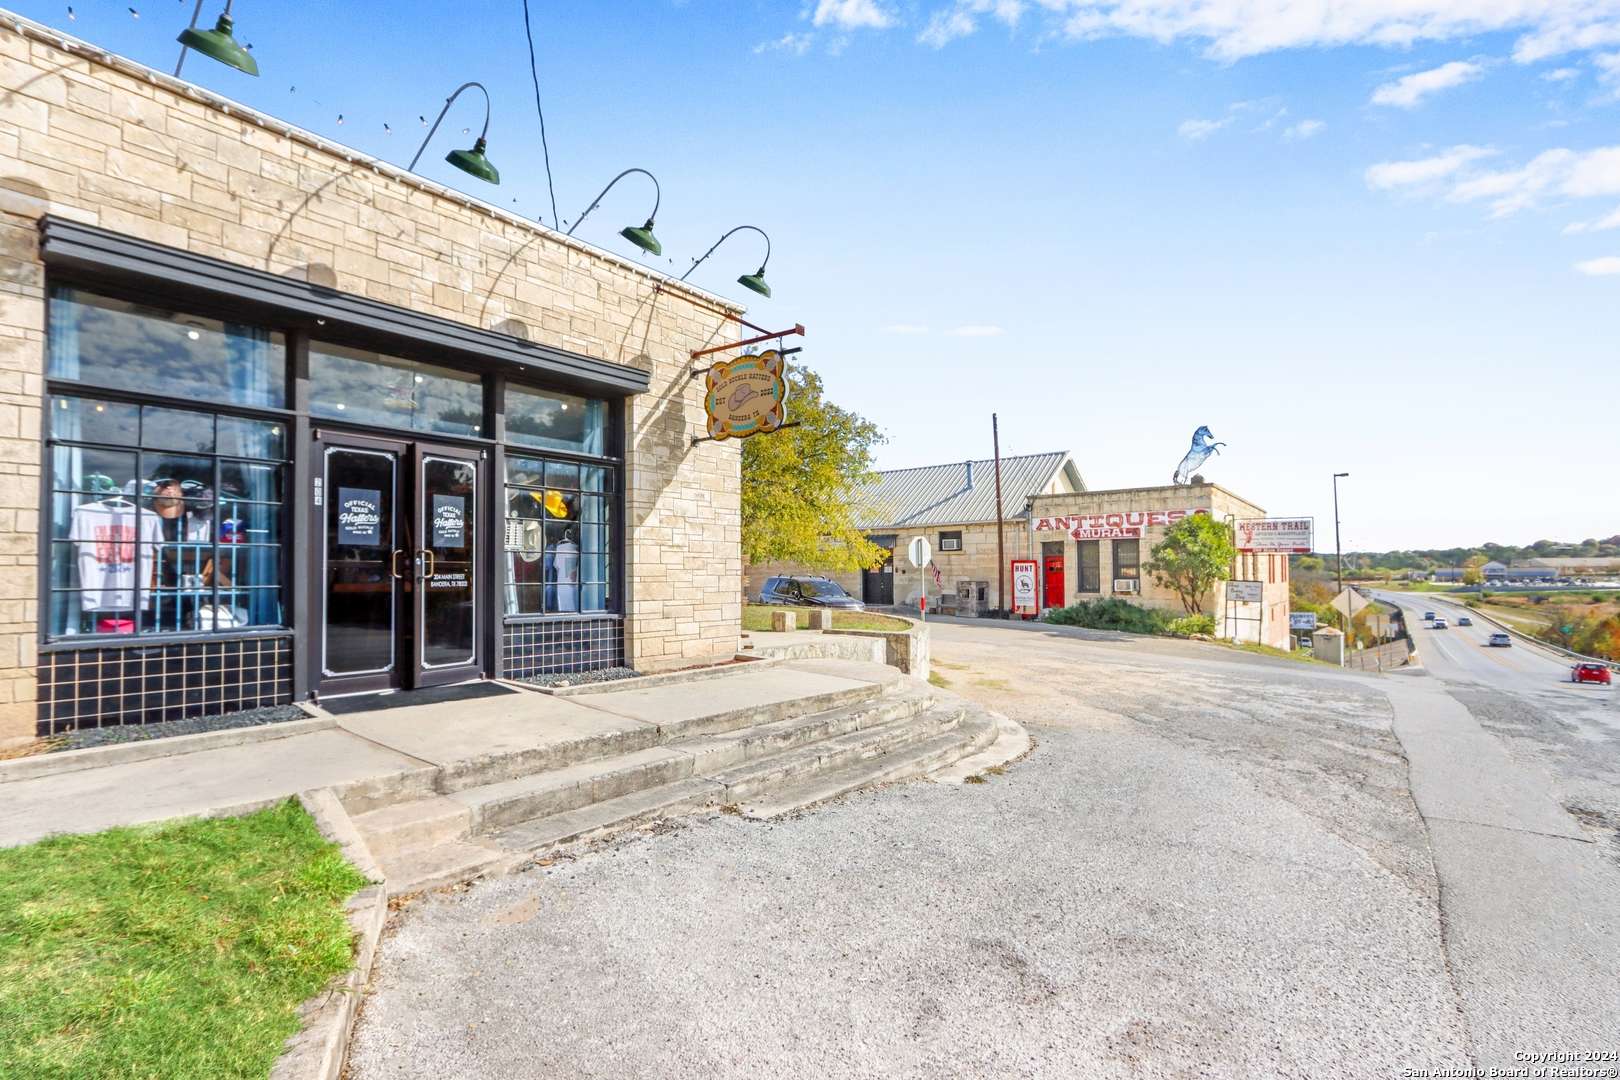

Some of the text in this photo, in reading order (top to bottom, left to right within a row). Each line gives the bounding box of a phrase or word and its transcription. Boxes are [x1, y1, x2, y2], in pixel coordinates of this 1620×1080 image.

[748, 373, 771, 382] HATTERS
[344, 500, 376, 512] OFFICIAL
[437, 505, 462, 516] OFFICIAL
[339, 513, 380, 526] Hatters
[433, 518, 465, 529] Hatters
[1035, 510, 1186, 532] ANTIQUES
[1239, 521, 1310, 531] WESTERN TRAIL
[1079, 528, 1133, 539] MURAL
[1015, 564, 1033, 573] HUNT
